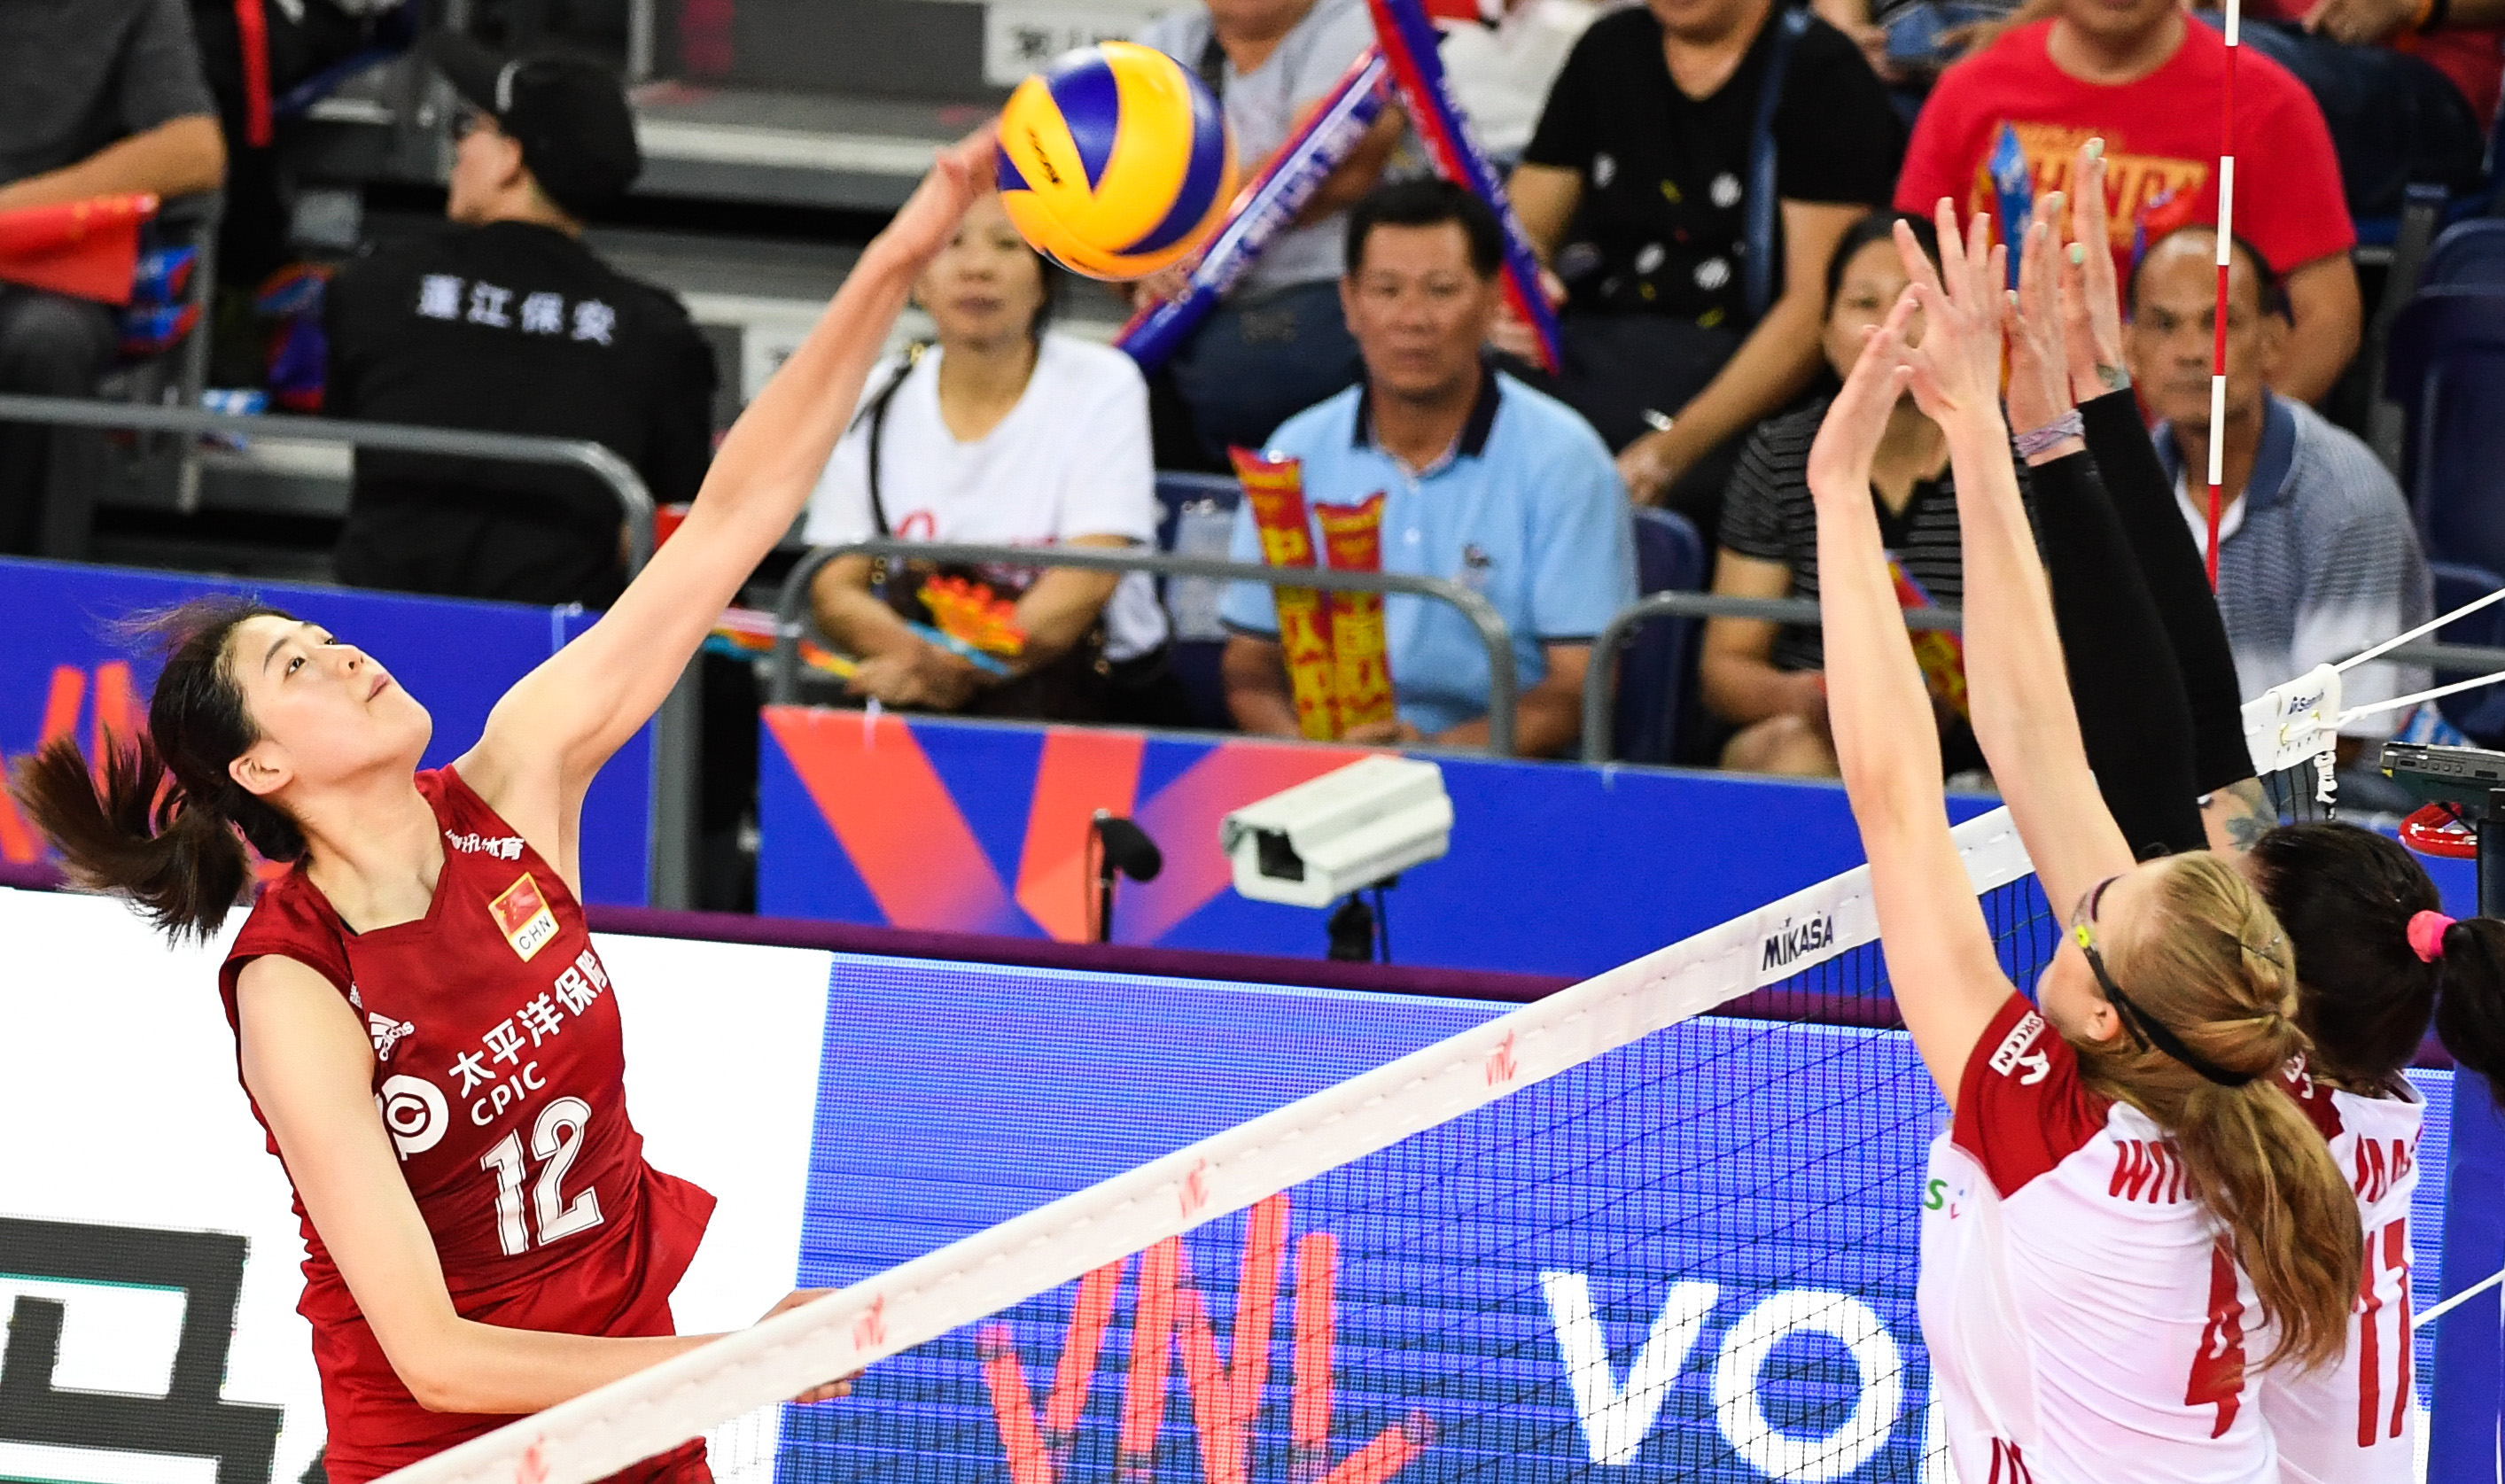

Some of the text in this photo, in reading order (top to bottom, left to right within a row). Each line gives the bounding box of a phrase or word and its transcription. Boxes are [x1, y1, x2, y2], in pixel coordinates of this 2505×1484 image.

[518, 916, 551, 950] CHN
[1762, 915, 1833, 971] MIKASA
[471, 1061, 547, 1126] CPIC
[479, 1096, 605, 1256] 12
[1538, 1271, 1949, 1484] VO
[2185, 1233, 2244, 1439] 4
